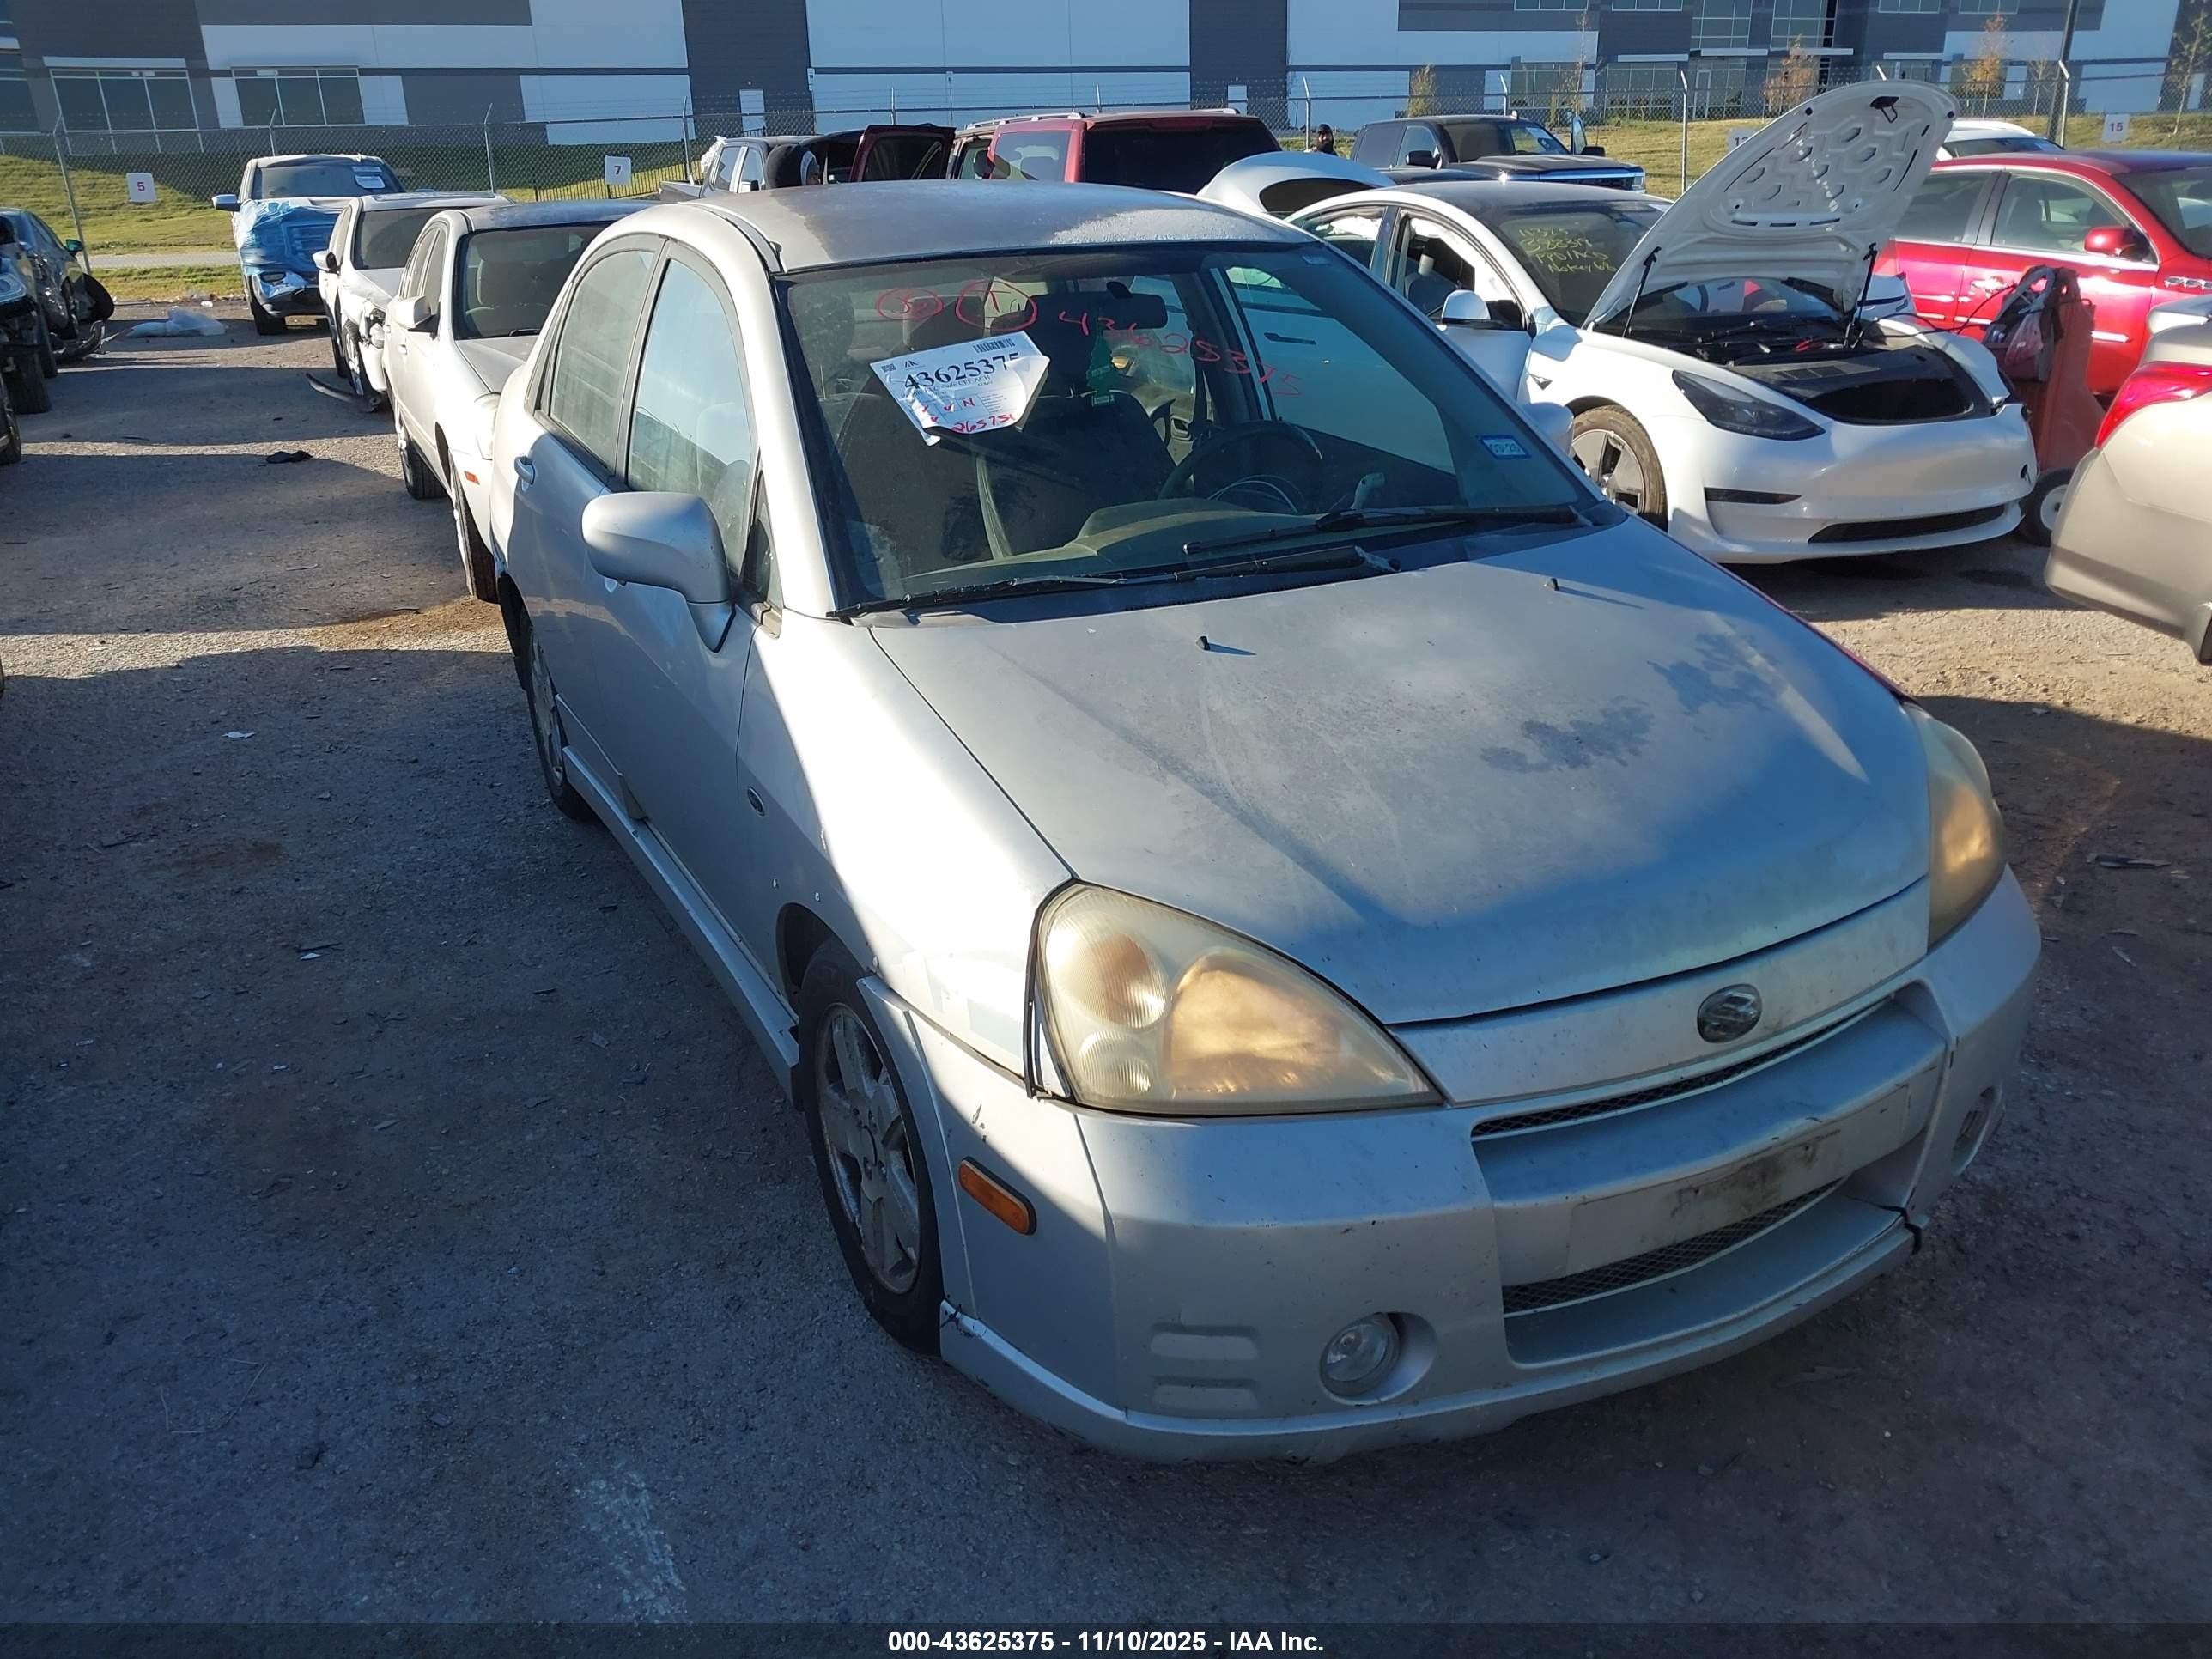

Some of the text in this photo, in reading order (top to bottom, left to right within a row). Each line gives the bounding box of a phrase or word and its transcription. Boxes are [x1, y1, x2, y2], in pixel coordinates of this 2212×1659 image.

[2110, 122, 2123, 131] 15
[614, 165, 622, 175] 7
[137, 181, 145, 191] 5
